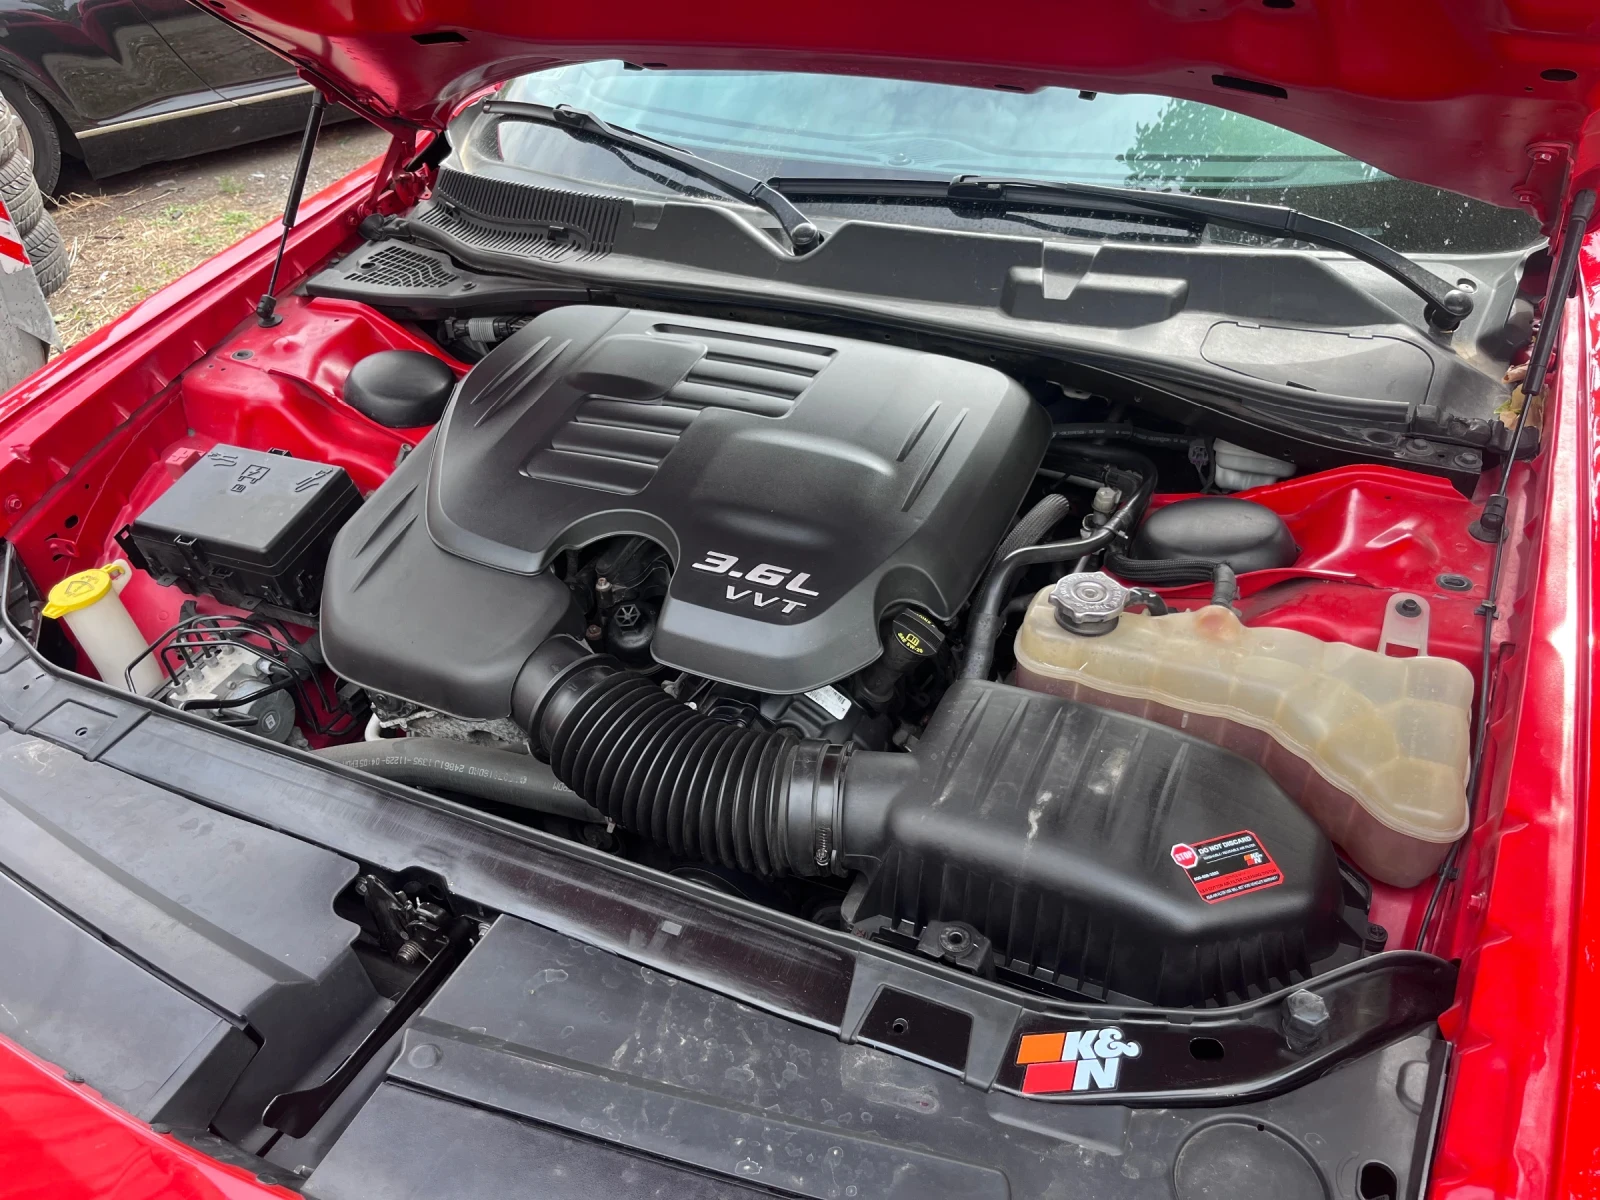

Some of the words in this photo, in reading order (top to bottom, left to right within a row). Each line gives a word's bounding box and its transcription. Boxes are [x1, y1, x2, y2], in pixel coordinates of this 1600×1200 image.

[691, 551, 820, 597] 3.6L
[725, 585, 807, 614] VVT
[1174, 850, 1193, 862] STOP
[1198, 847, 1209, 855] DO
[1209, 842, 1223, 852] NOT
[1223, 836, 1253, 848] DISCARD
